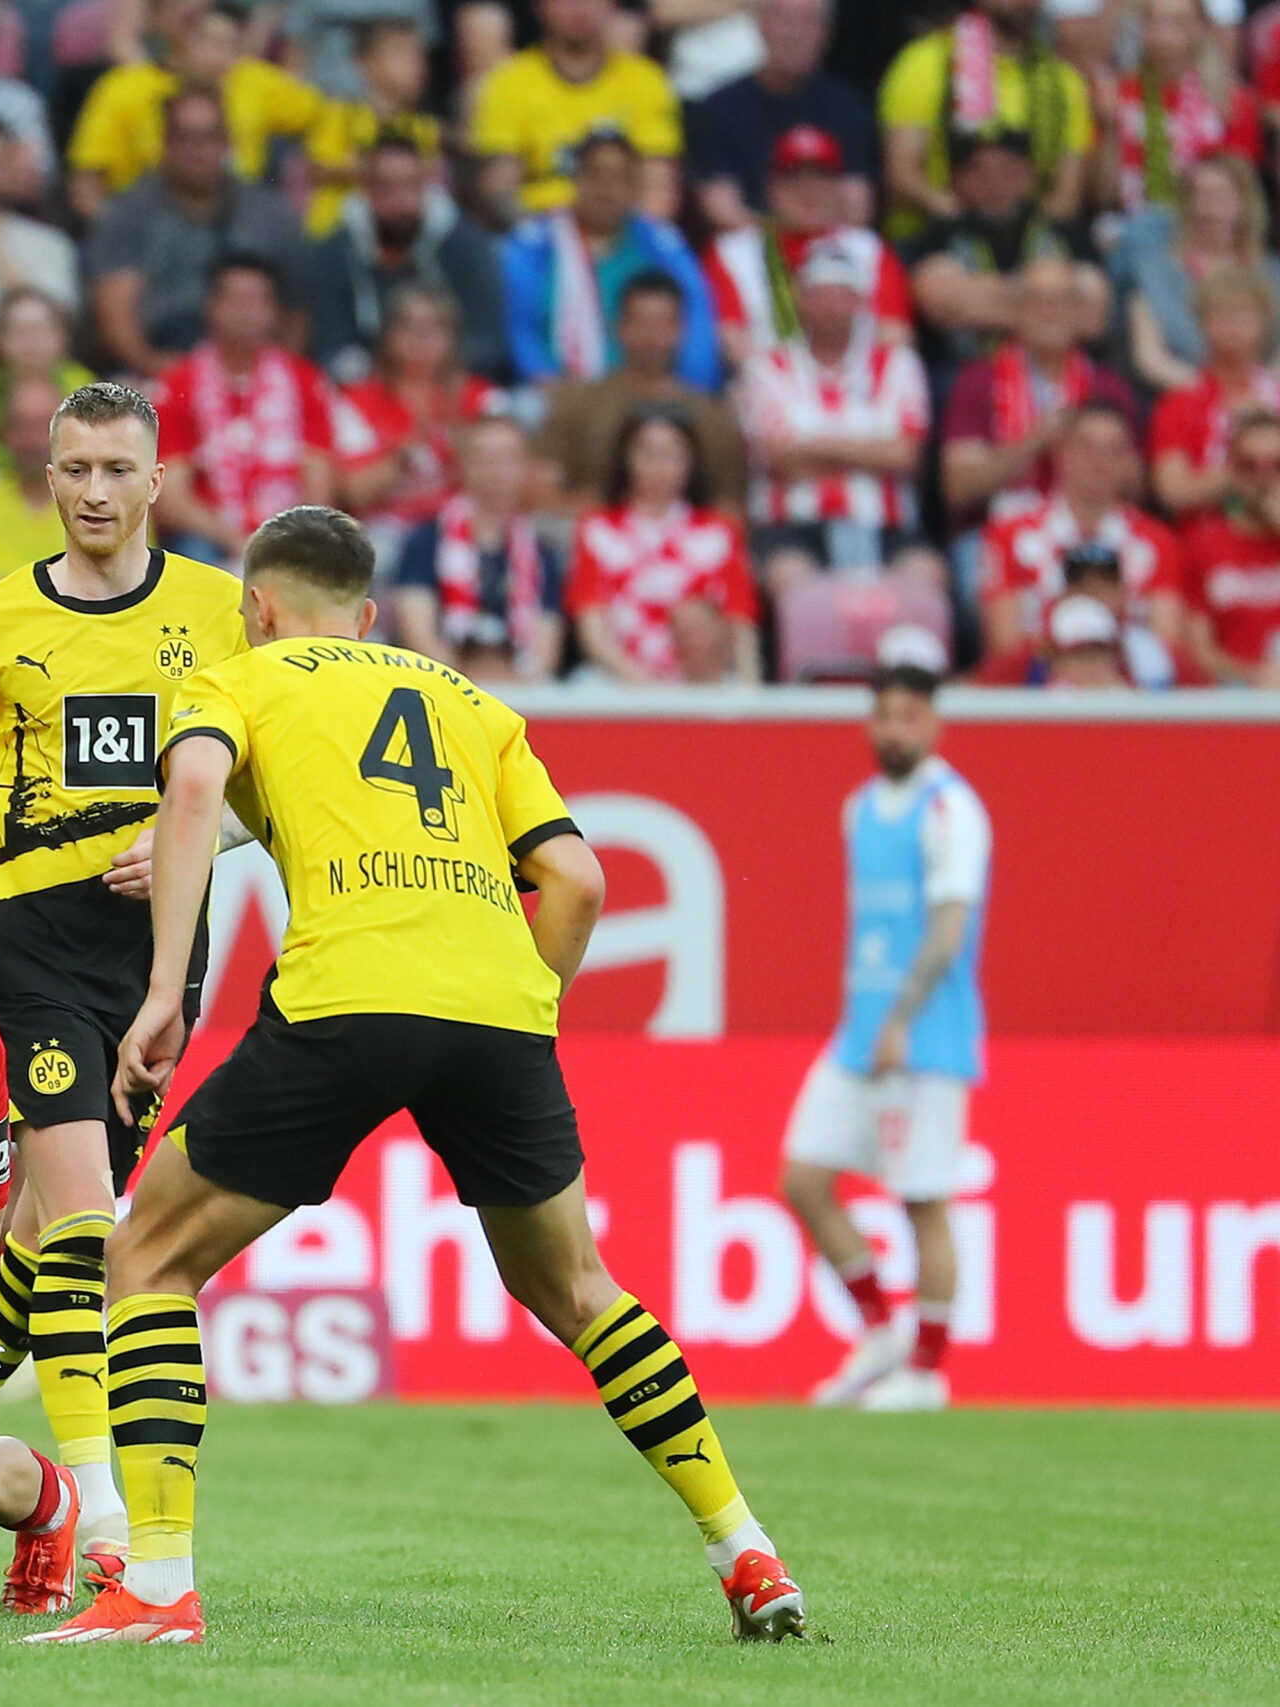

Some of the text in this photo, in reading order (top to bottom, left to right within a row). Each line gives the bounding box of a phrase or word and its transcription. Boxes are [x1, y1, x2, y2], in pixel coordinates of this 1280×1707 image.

[160, 642, 194, 667] BVB
[170, 667, 183, 677] 09
[72, 716, 145, 763] 1&1
[359, 687, 456, 832] 4
[330, 851, 520, 916] N. SCHLOTTERBECK
[35, 1055, 70, 1084] BVB
[48, 1079, 61, 1090] 09
[69, 1294, 90, 1304] 19
[179, 1386, 200, 1398] 19
[629, 1382, 660, 1402] 09
